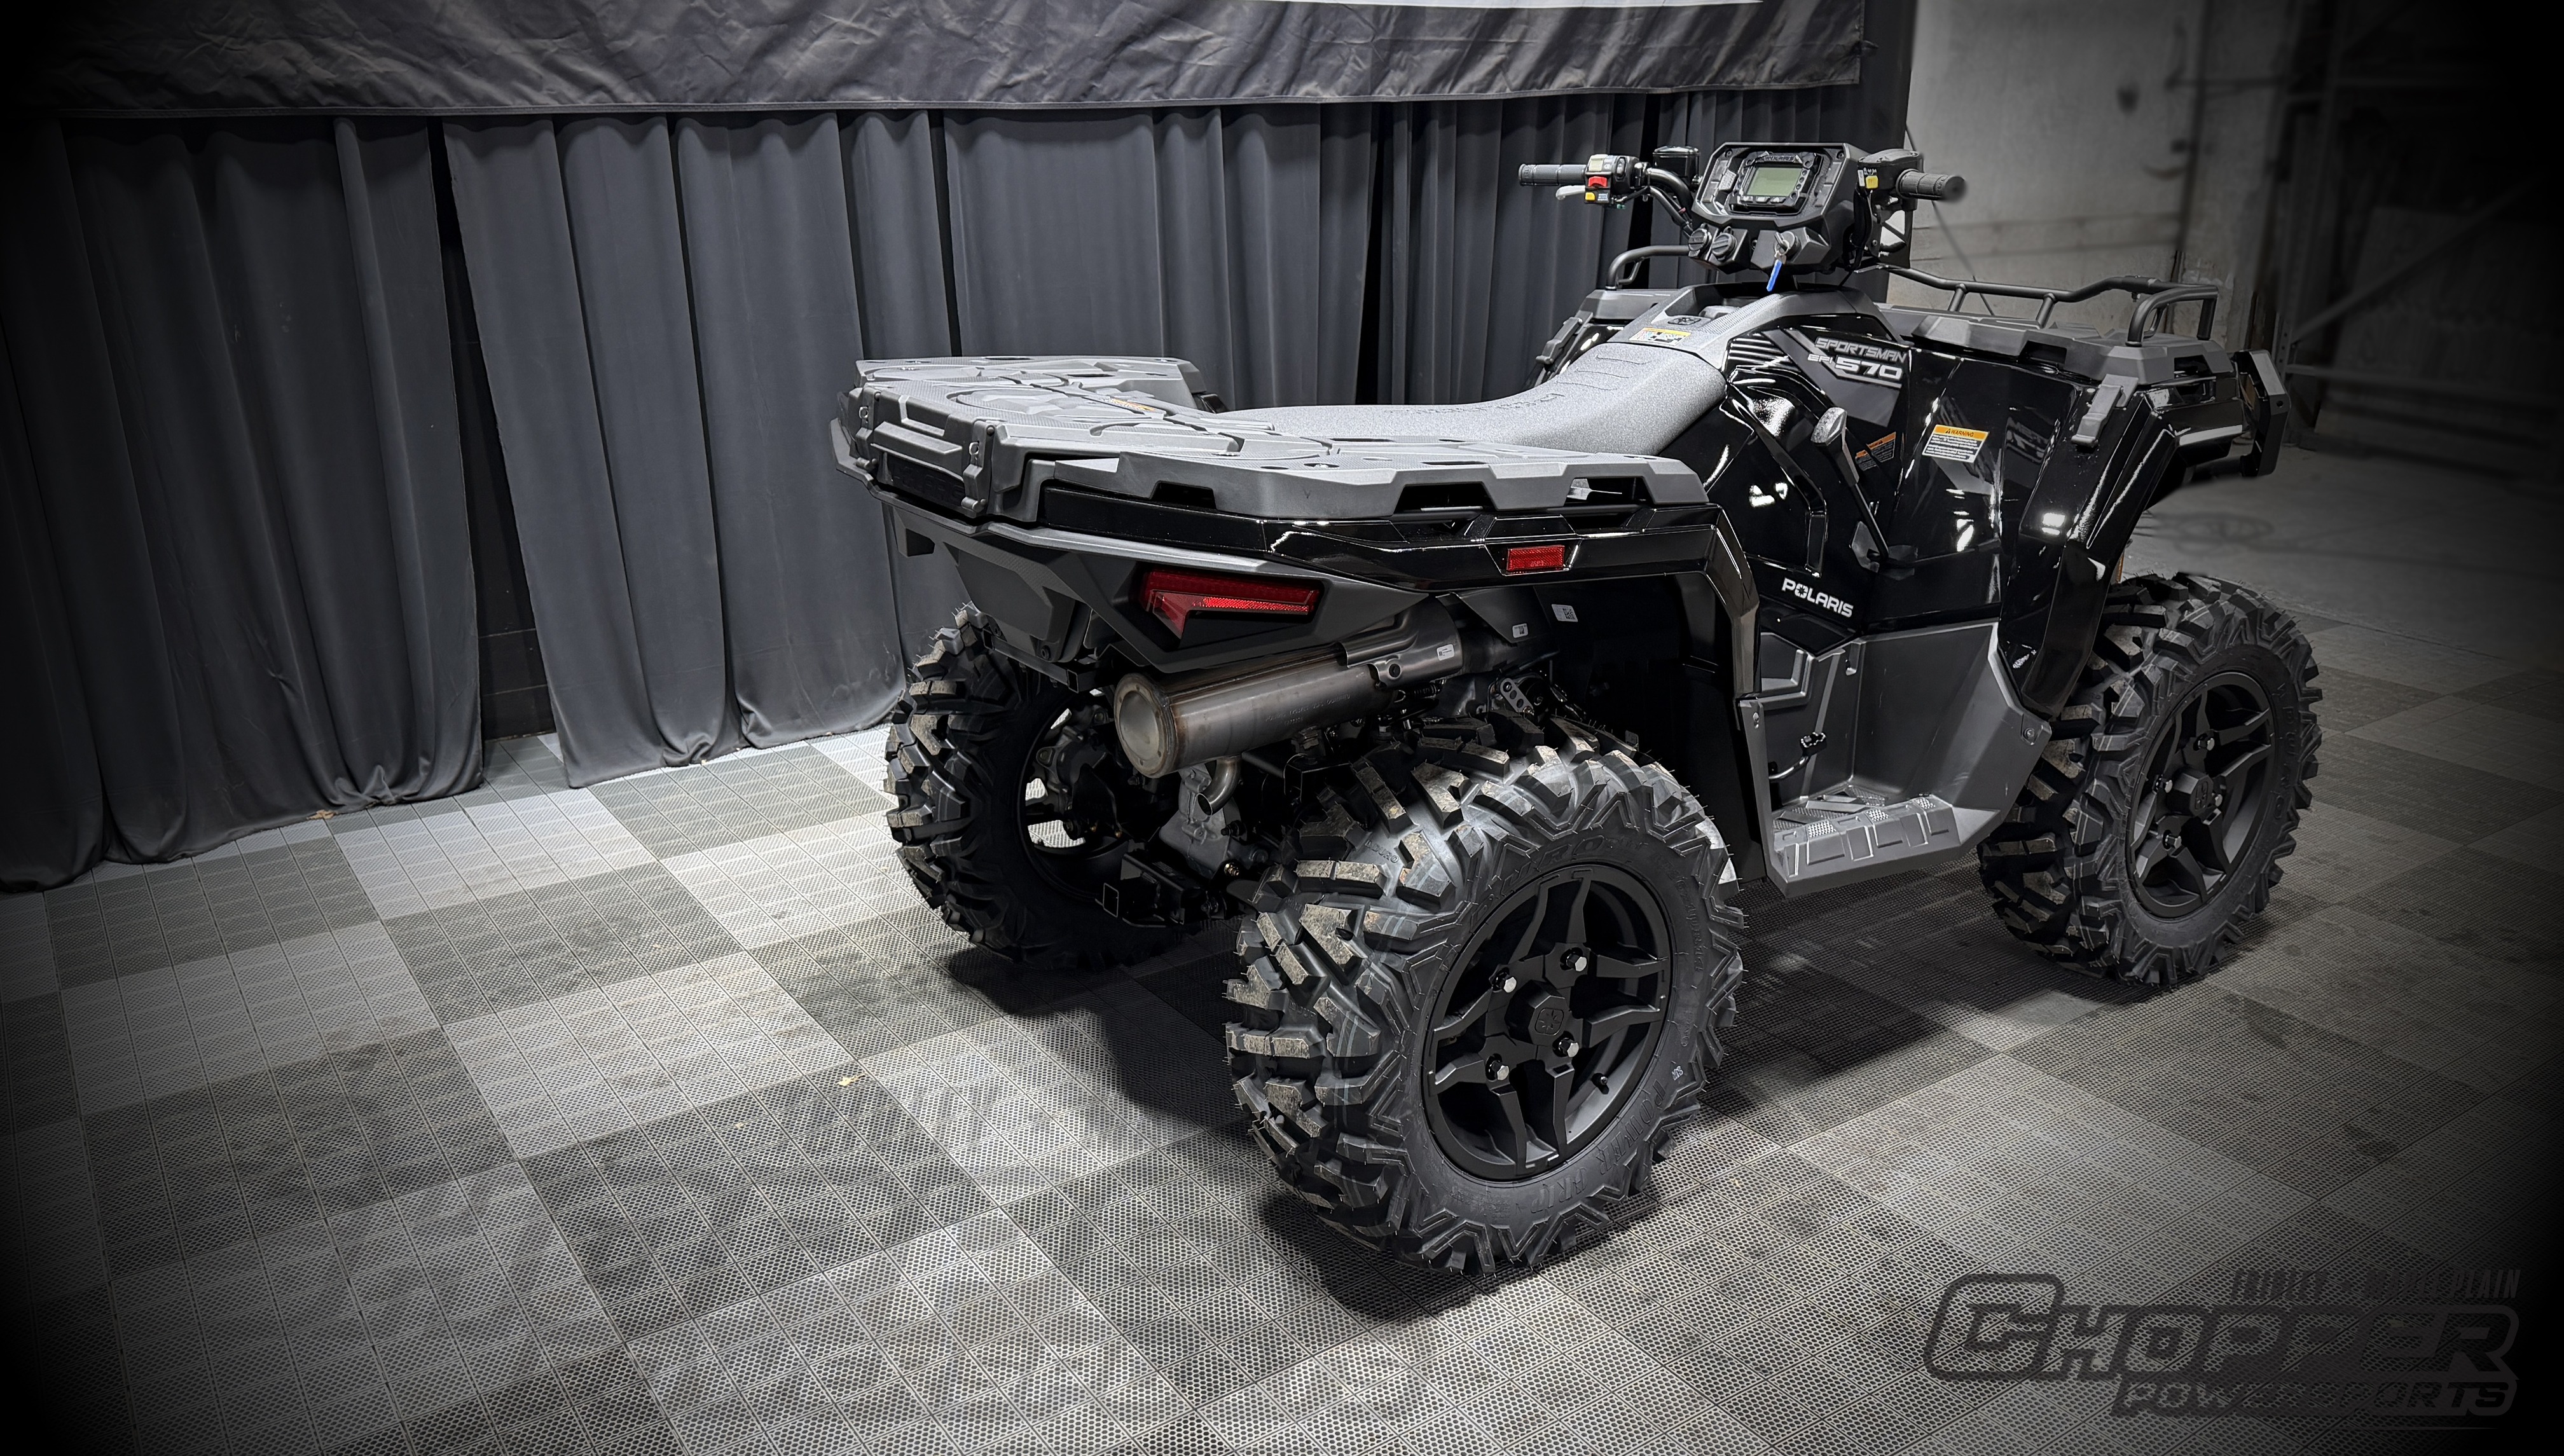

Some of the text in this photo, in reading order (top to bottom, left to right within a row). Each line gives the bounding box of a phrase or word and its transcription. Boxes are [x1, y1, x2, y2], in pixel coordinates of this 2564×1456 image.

[1814, 336, 1907, 363] SPORTSMAN
[1807, 354, 1903, 380] EFI 570
[1951, 429, 1975, 437] WARNING
[1781, 577, 1854, 618] POLARIS
[1470, 835, 1605, 934] DURO
